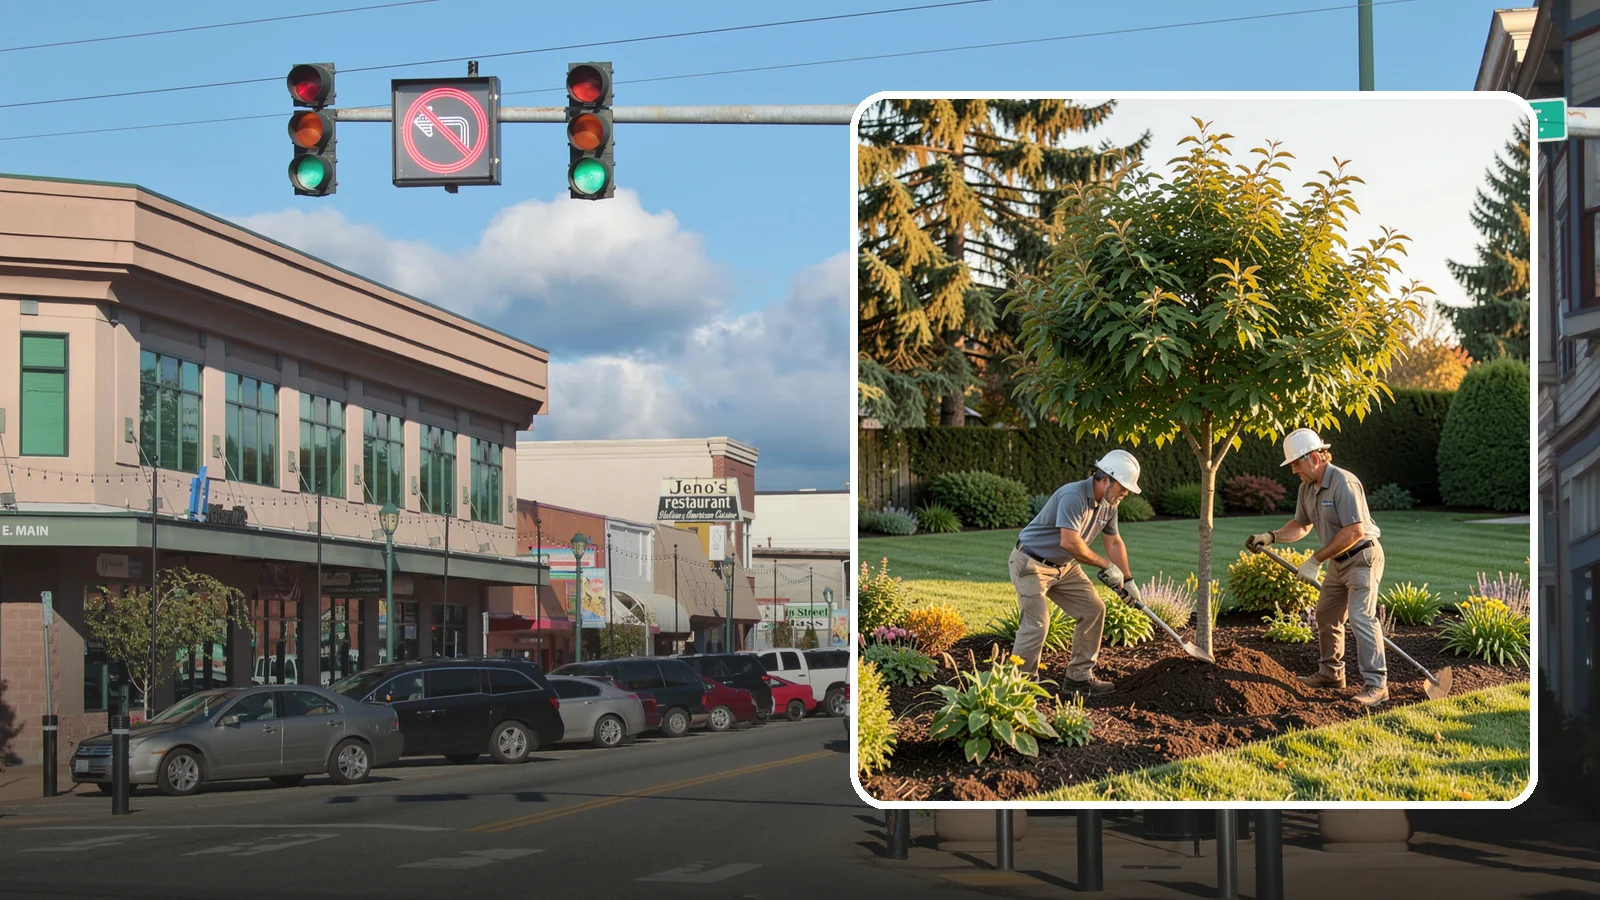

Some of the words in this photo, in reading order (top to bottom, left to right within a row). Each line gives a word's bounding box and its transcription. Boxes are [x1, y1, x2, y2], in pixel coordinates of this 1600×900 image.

[669, 480, 728, 494] Jeno's
[665, 496, 731, 509] restaurant
[658, 509, 682, 519] Italian
[686, 509, 714, 519] American
[715, 509, 738, 519] Cuisine
[2, 525, 13, 536] E.
[15, 525, 49, 536] MAIN
[797, 607, 828, 616] Street
[790, 618, 823, 627] lass
